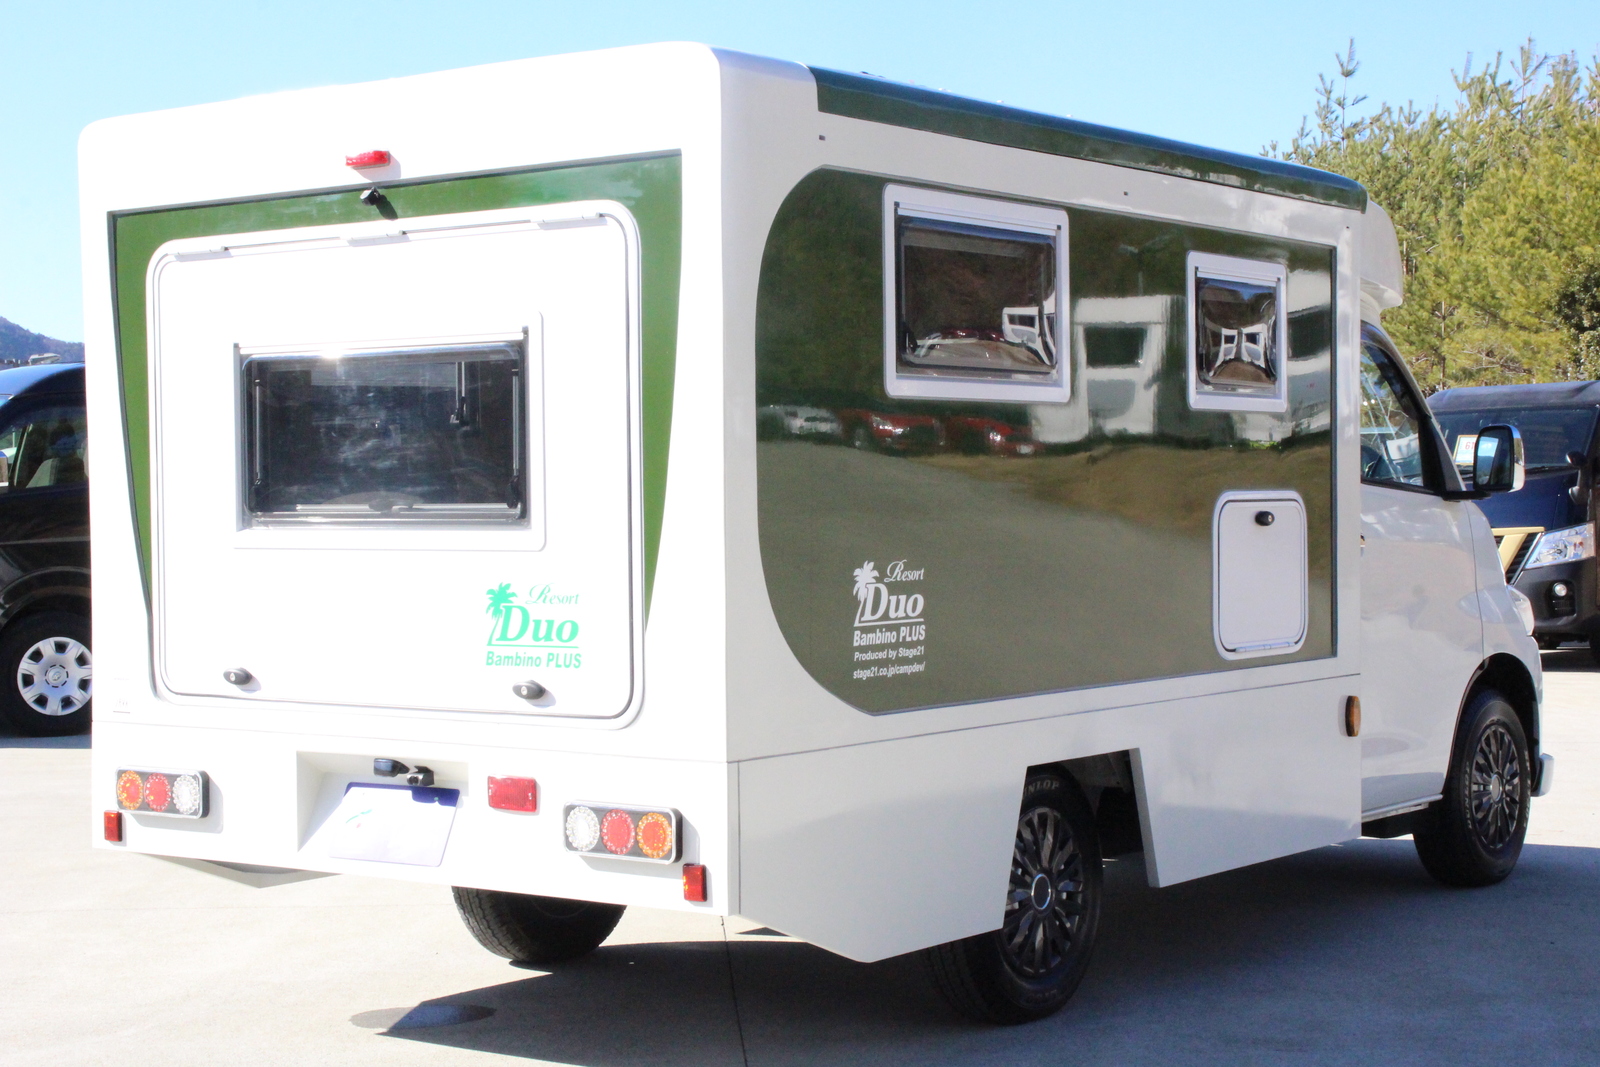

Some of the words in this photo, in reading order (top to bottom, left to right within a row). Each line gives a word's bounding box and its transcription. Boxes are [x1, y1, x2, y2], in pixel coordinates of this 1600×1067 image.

[884, 559, 925, 583] Resort
[525, 582, 580, 605] Resort
[861, 583, 925, 622] Duo
[495, 605, 579, 643] Duo
[853, 629, 897, 647] Bambino
[899, 625, 926, 643] PLUS
[486, 651, 542, 668] Bambino
[545, 652, 582, 669] PLUS
[854, 649, 887, 662] Produced
[888, 648, 897, 660] by
[898, 645, 925, 658] Stage21
